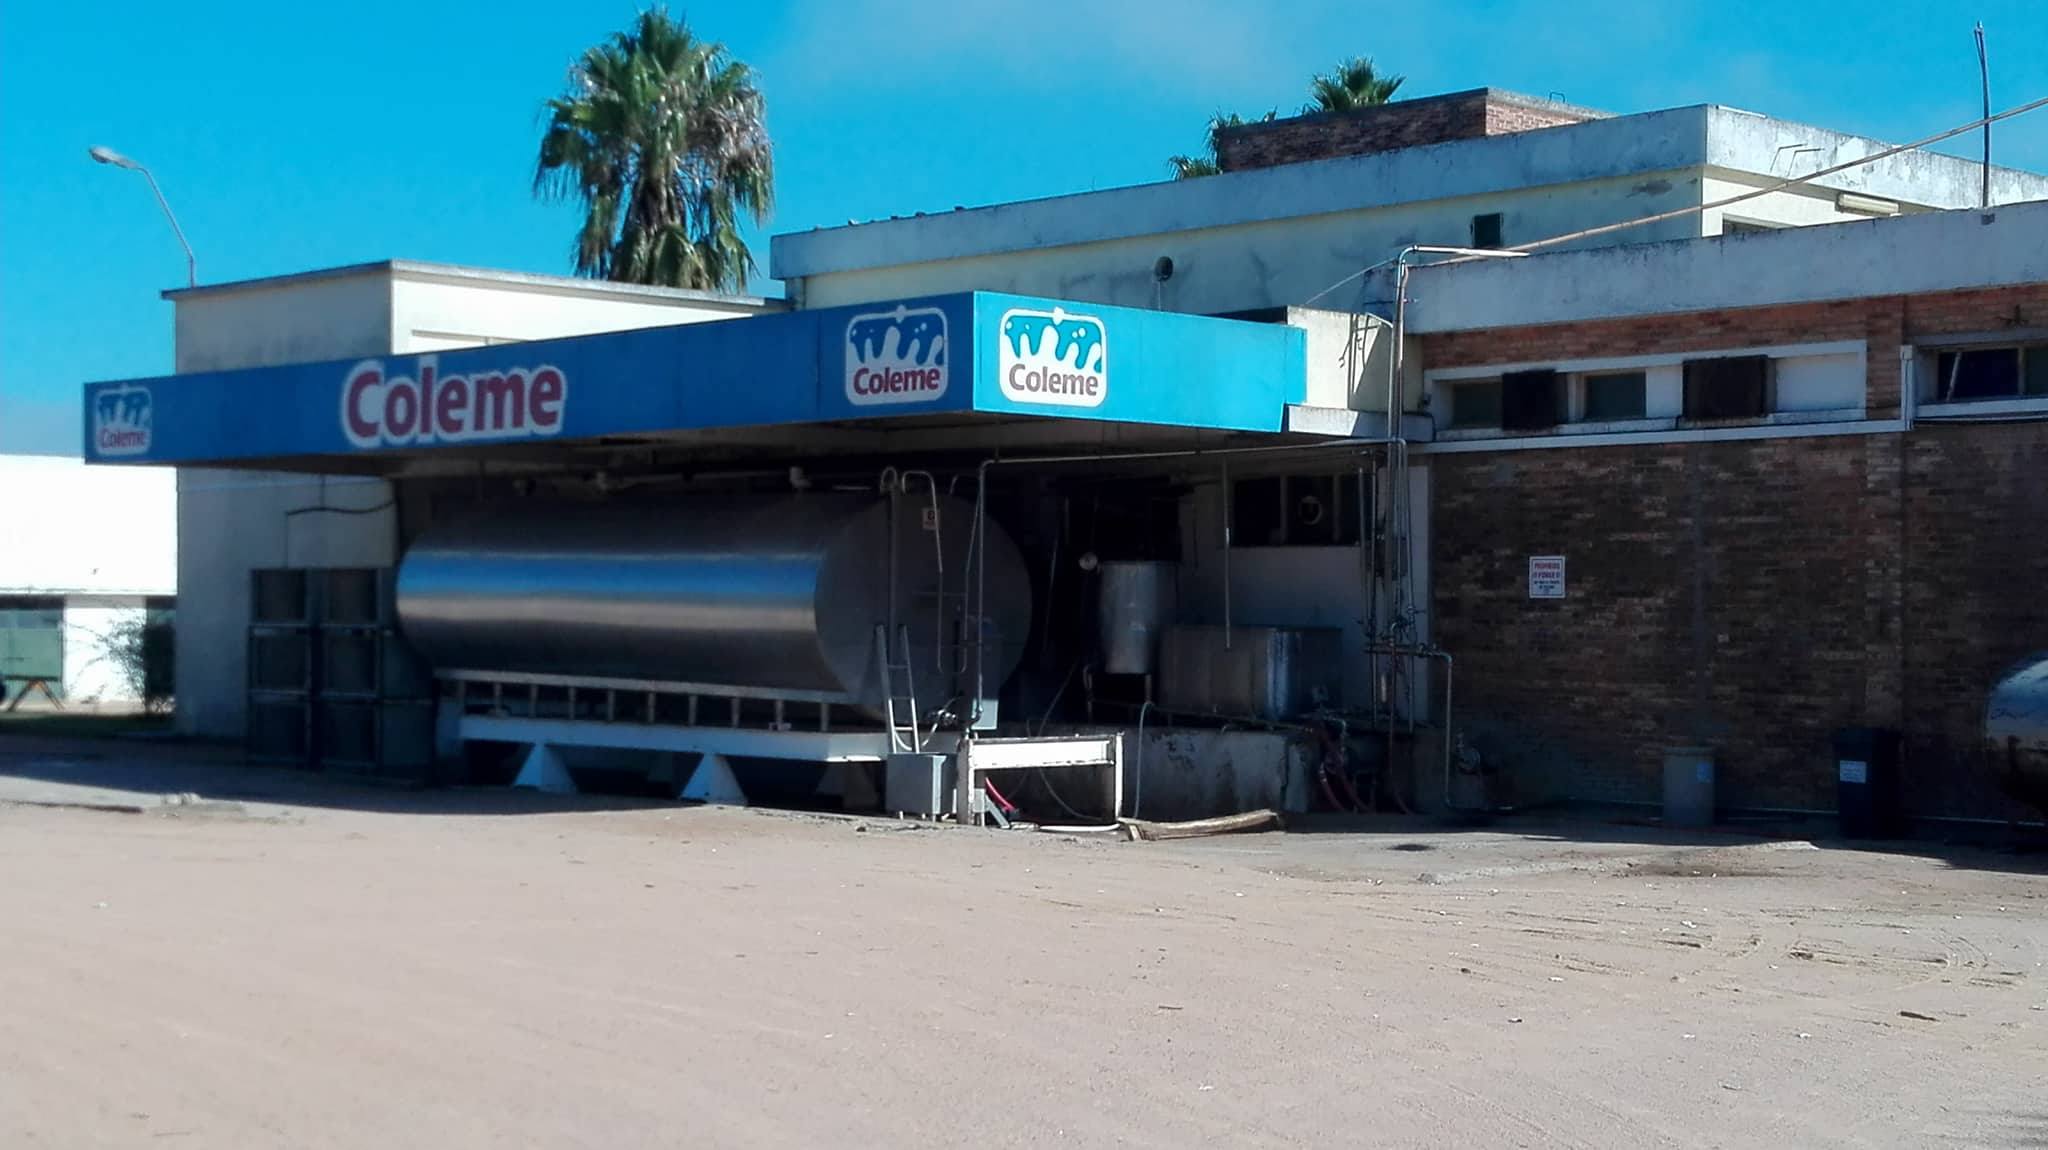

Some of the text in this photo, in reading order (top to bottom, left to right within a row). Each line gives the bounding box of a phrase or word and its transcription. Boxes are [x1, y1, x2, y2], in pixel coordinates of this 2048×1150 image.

[854, 367, 940, 395] Coleme
[1009, 364, 1098, 396] Coleme
[348, 367, 562, 438] Coleme
